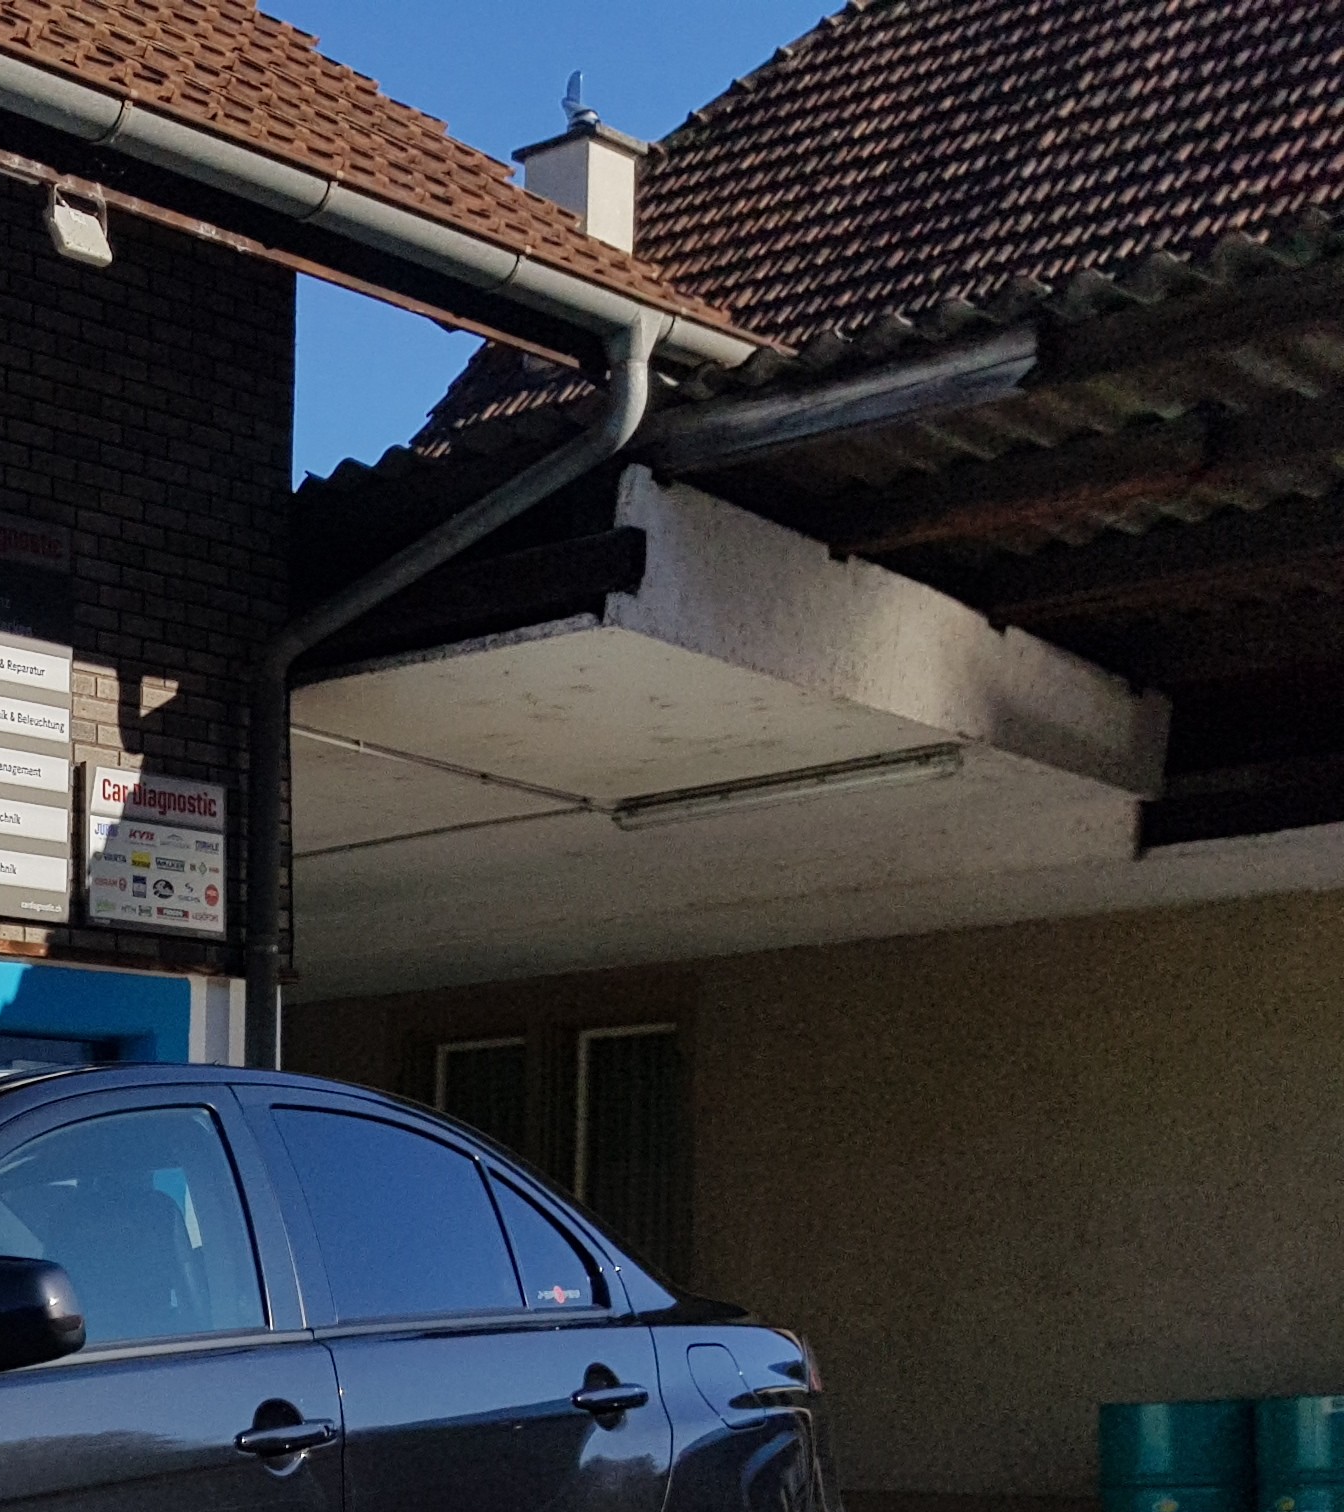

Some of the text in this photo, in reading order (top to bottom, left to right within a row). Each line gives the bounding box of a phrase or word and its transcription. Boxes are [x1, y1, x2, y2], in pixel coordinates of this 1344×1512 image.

[7, 660, 46, 676] Reparatur
[17, 713, 65, 734] Beleuchtung
[102, 778, 217, 818] Car Diagnostic
